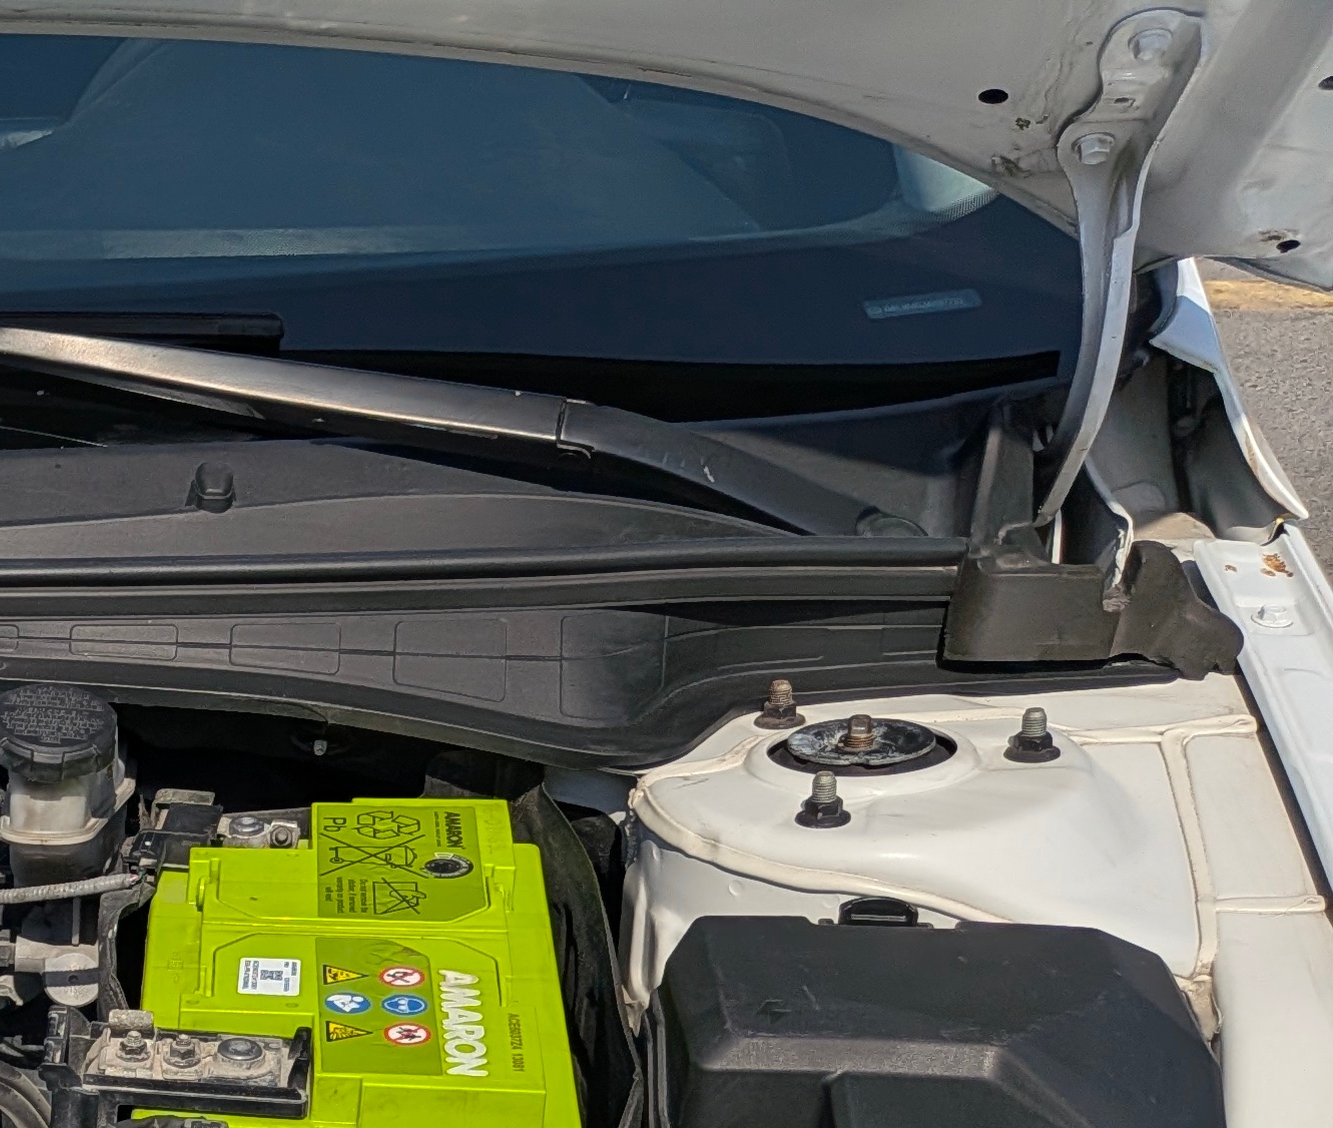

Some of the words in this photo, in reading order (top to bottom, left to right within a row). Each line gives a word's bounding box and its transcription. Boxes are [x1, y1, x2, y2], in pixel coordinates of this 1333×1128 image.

[323, 817, 346, 832] Pb
[443, 811, 464, 849] AMARON
[438, 969, 489, 1077] AMARON
